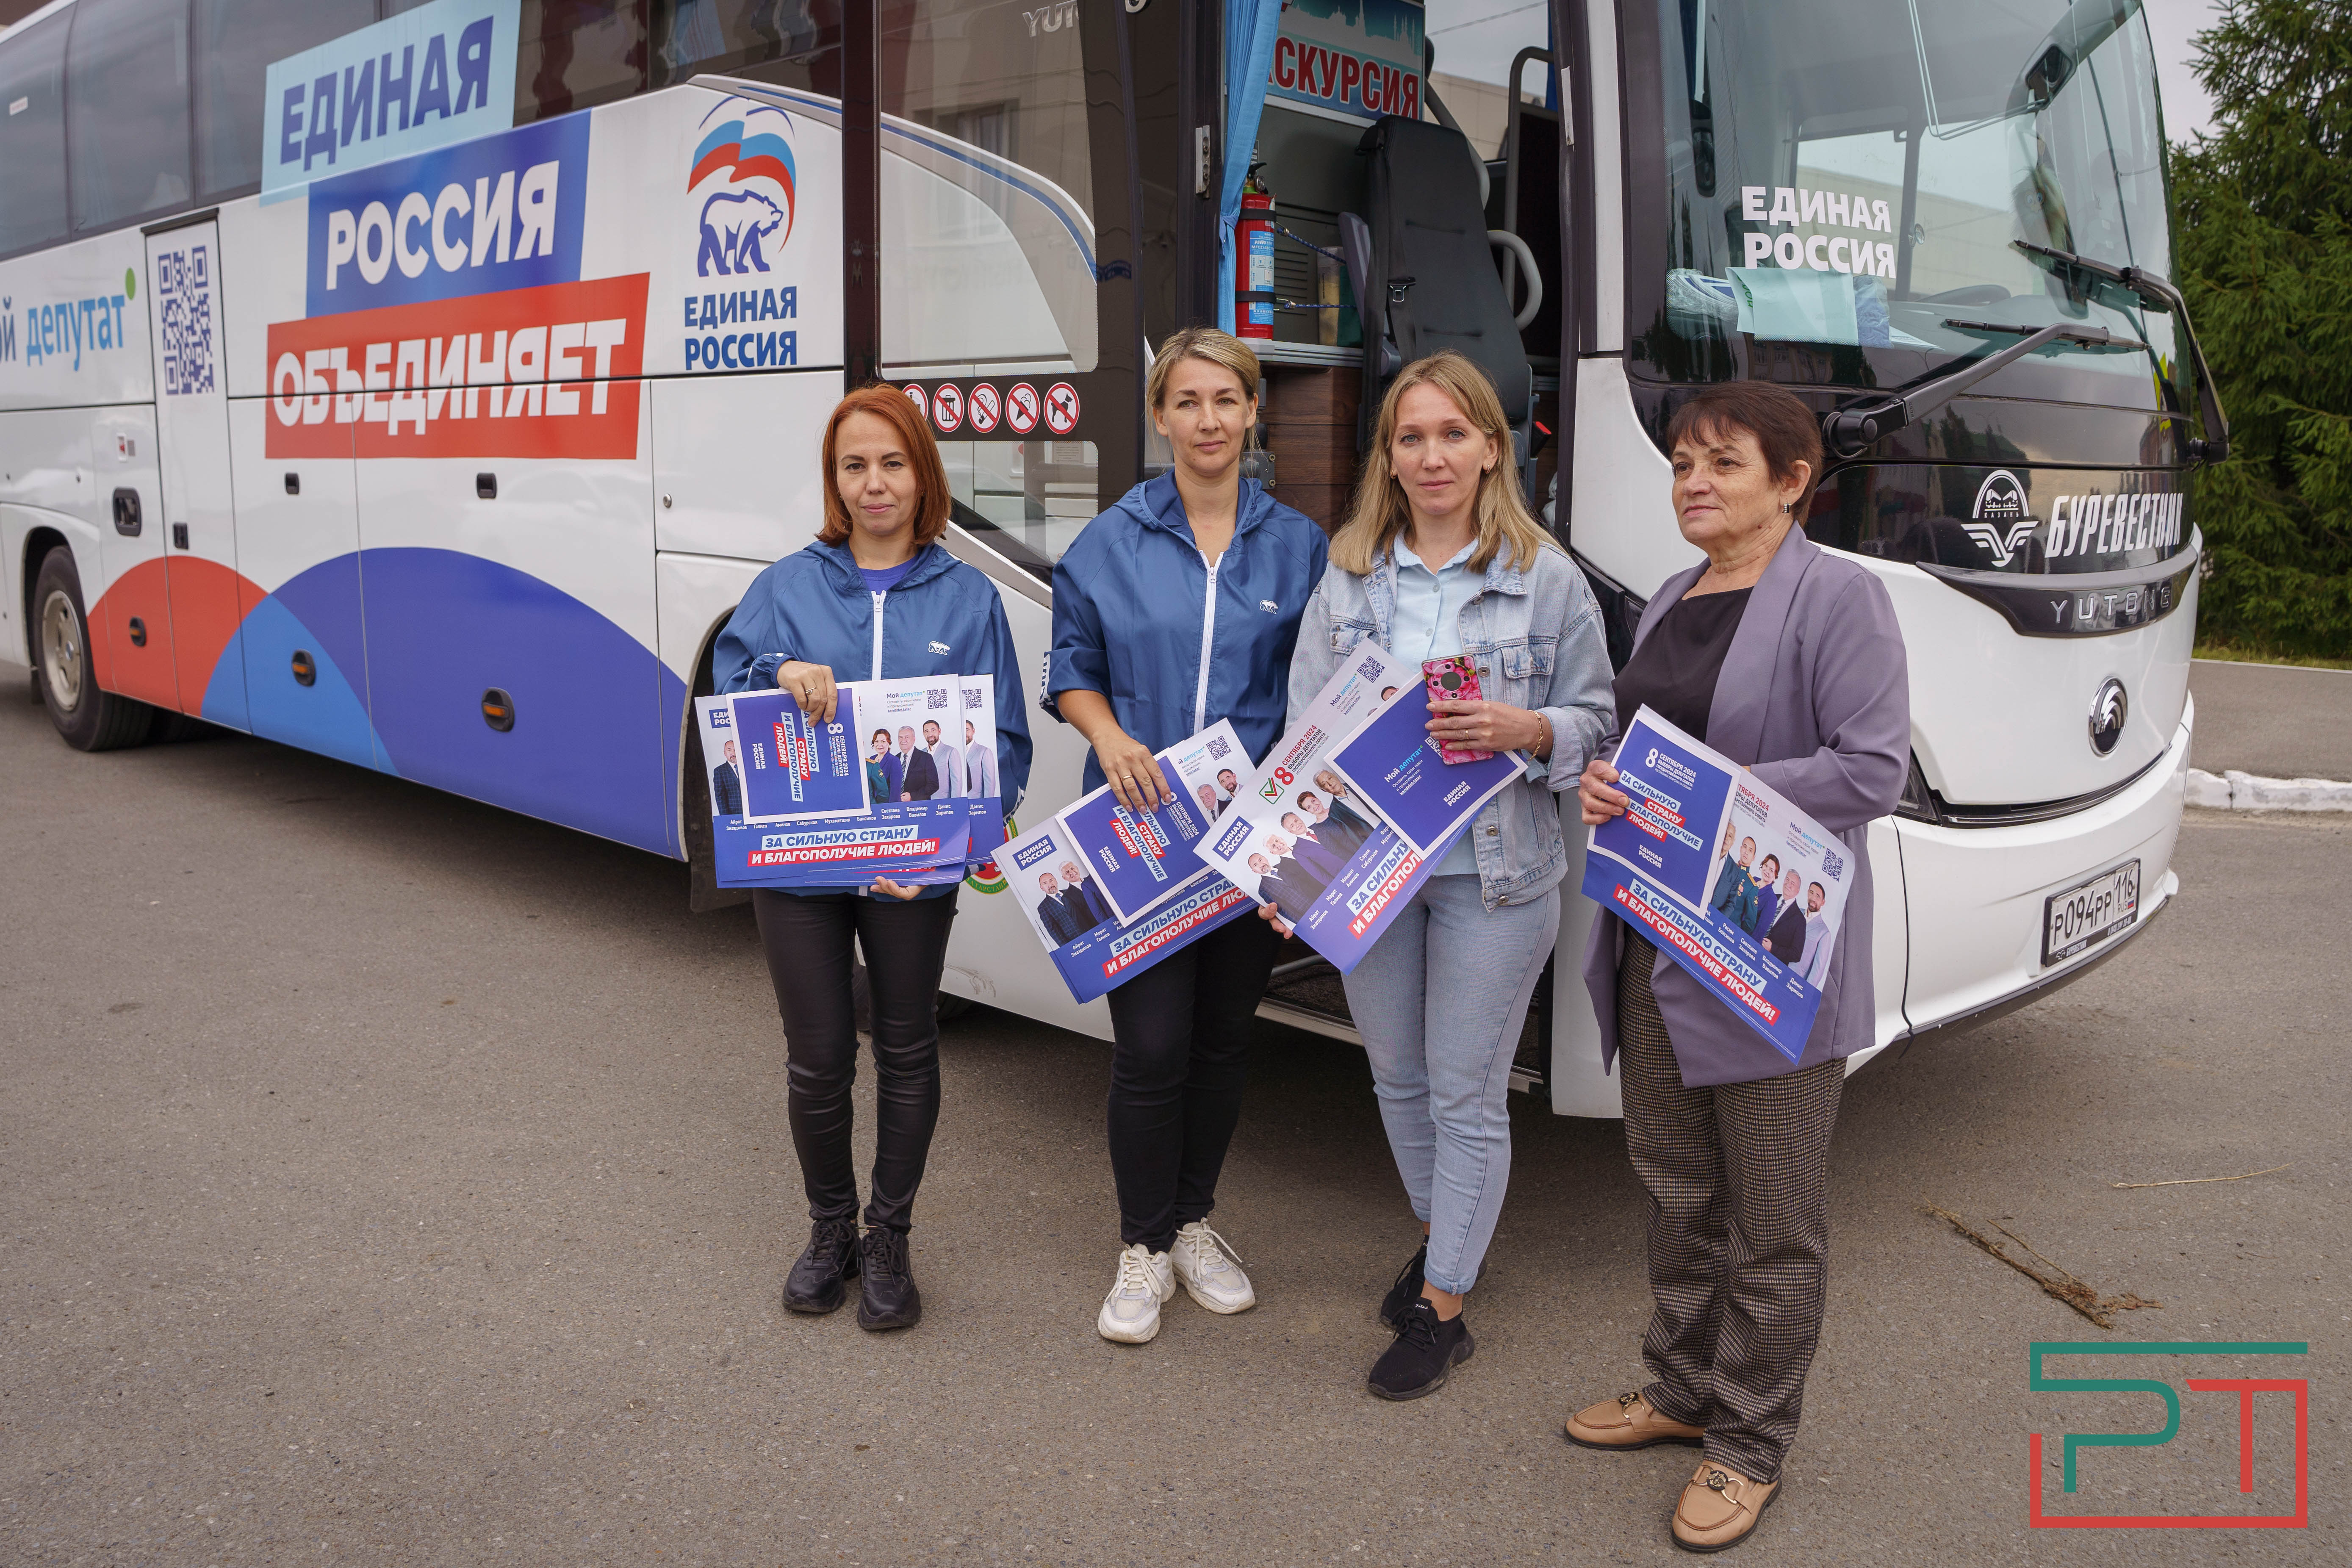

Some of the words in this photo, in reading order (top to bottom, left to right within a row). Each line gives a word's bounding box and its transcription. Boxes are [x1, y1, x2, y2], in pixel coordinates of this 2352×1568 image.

[1269, 36, 1419, 120] СКУРСИЯ
[280, 15, 494, 172] ЕДИНАЯ
[1741, 186, 1891, 234] ЕДИНАЯ
[326, 160, 560, 291] РОССИЯ
[1744, 232, 1895, 279] РОССИЯ
[684, 285, 797, 330] ЕДИНАЯ
[26, 295, 125, 371] депутат
[685, 330, 798, 370] РОССИЯ
[273, 318, 626, 435] ОБЪЕДИНЯЕТ
[2045, 493, 2183, 557] БУРЕВЕСТНИК
[2050, 587, 2171, 623] YUTONG
[1330, 694, 1342, 706] Мой
[1340, 676, 1357, 696] депутат
[827, 723, 843, 734] 8
[752, 743, 761, 769] РОССИЯ
[758, 743, 766, 769] ЕДИНАЯ
[776, 725, 788, 764] ЛЮДЕЙ!
[1184, 748, 1203, 762] депутат
[1282, 738, 1306, 766] СЕНТЯБРЯ
[1304, 725, 1317, 740] 2024
[1288, 751, 1305, 770] ВЫБОРЫ
[1305, 729, 1322, 752] ДЕПУТАТОВ
[1292, 744, 1316, 773] ГОСУДАРСТВЕННОГО
[1316, 733, 1326, 744] СОВЕТА
[785, 724, 801, 800] БЛАГОПОЛУЧИЕ
[798, 741, 808, 778] СТРАНУ
[1384, 767, 1400, 783] Мой
[1399, 748, 1423, 771] депутат
[1646, 748, 1658, 767] 8
[1660, 753, 1684, 770] СЕНТЯБРЯ
[1683, 767, 1696, 778] 2024
[1274, 767, 1294, 785] 8
[1392, 774, 1407, 788] Оставить
[1407, 766, 1415, 775] свои
[1657, 759, 1674, 771] ВЫБОРЫ
[1673, 769, 1695, 783] ДЕПУТАТОВ
[1443, 781, 1467, 803] ЕДИНАЯ
[1447, 785, 1471, 806] РОССИЯ
[1621, 773, 1631, 784] ЗА
[1632, 781, 1677, 809] СИЛЬНУЮ
[1739, 784, 1755, 801] ТЯБРЯ
[1756, 797, 1769, 811] 2024
[1647, 801, 1682, 824] СТРАНУ
[1736, 791, 1745, 801] ОРЫ
[1745, 798, 1767, 817] ДЕПУТАТОВ
[1144, 812, 1166, 844] ЛЬНУЮ
[1172, 804, 1183, 820] ВЫБОРЫ
[1181, 819, 1194, 838] ДЕПУТАТОВ
[1176, 801, 1192, 824] СЕНТЯБРЯ
[1190, 824, 1200, 835] 2024
[1629, 814, 1664, 839] ЛЮДЕЙ!
[1630, 802, 1700, 847] БЛАГОПОЛУЧИЕ
[765, 837, 783, 848] ЗА
[786, 832, 856, 846] СИЛЬНУЮ
[859, 828, 914, 841] СТРАНУ
[1112, 822, 1138, 855] ЛЮДЕЙ!
[1121, 815, 1164, 879] БЛАГОПОЛУЧИЕ
[1139, 825, 1163, 855] СТРАНУ
[1217, 821, 1243, 852] ЕДИНАЯ
[1223, 826, 1249, 856] РОССИЯ
[1380, 830, 1394, 845] Мухаме
[1790, 822, 1801, 834] Мой
[1801, 832, 1823, 849] депутат
[752, 853, 762, 864] И
[764, 845, 875, 864] БЛАГОПОЛУЧИЕ
[877, 839, 936, 856] ЛЮДЕЙ!
[1017, 839, 1049, 861] ЕДИНАЯ
[1021, 845, 1052, 867] РОССИЯ
[1099, 849, 1116, 873] РОССИЯ
[1103, 846, 1120, 870] ЕДИНАЯ
[1359, 849, 1371, 862] Сария
[1361, 849, 1379, 869] Сабурская
[1638, 850, 1662, 868] РОССИЯ
[1640, 844, 1662, 863] ЕДИНАЯ
[1190, 876, 1208, 888] Баксиков
[1340, 868, 1355, 884] Ильшат
[1346, 873, 1360, 888] Аминов
[1351, 891, 1369, 910] ЗА
[1367, 842, 1408, 892] СИЛЬНУ
[2115, 869, 2133, 903] 116
[1325, 889, 1338, 902] Марат
[1330, 892, 1343, 906] Галиев
[1352, 919, 1366, 934] И
[1362, 852, 1421, 923] БЛАГОПОЛ
[1114, 939, 1132, 953] ЗА
[1133, 898, 1197, 941] СИЛЬНУЮ
[1199, 880, 1234, 900] СТРА
[1308, 909, 1319, 922] Айрат
[2118, 900, 2127, 913] RUS
[1094, 928, 1107, 937] Марат
[1310, 910, 1328, 930] Зиатдинов
[1723, 923, 1734, 935] Расим
[1072, 941, 1084, 950] Айрат
[1096, 932, 1110, 942] Галиев
[1107, 961, 1117, 975] И
[1119, 901, 1220, 967] БЛАГОПОЛУЧИЕ
[1633, 884, 1648, 902] ЗА
[1651, 897, 1712, 949] СИЛЬНУЮ
[1713, 946, 1762, 986] СТРАНУ
[1718, 927, 1735, 944] Баксиков
[1740, 938, 1757, 955] Светлана
[1617, 889, 1628, 903] И
[1628, 896, 1723, 978] БЛАГОПОЛУЧИЕ
[1721, 972, 1776, 1020] ЛЮДЕЙ!
[1738, 944, 1756, 961] Захарова
[1762, 955, 1782, 975] Владимир
[1762, 963, 1779, 979] Вавилов
[1786, 982, 1803, 999] Зарипов
[1790, 978, 1803, 991] Данис
